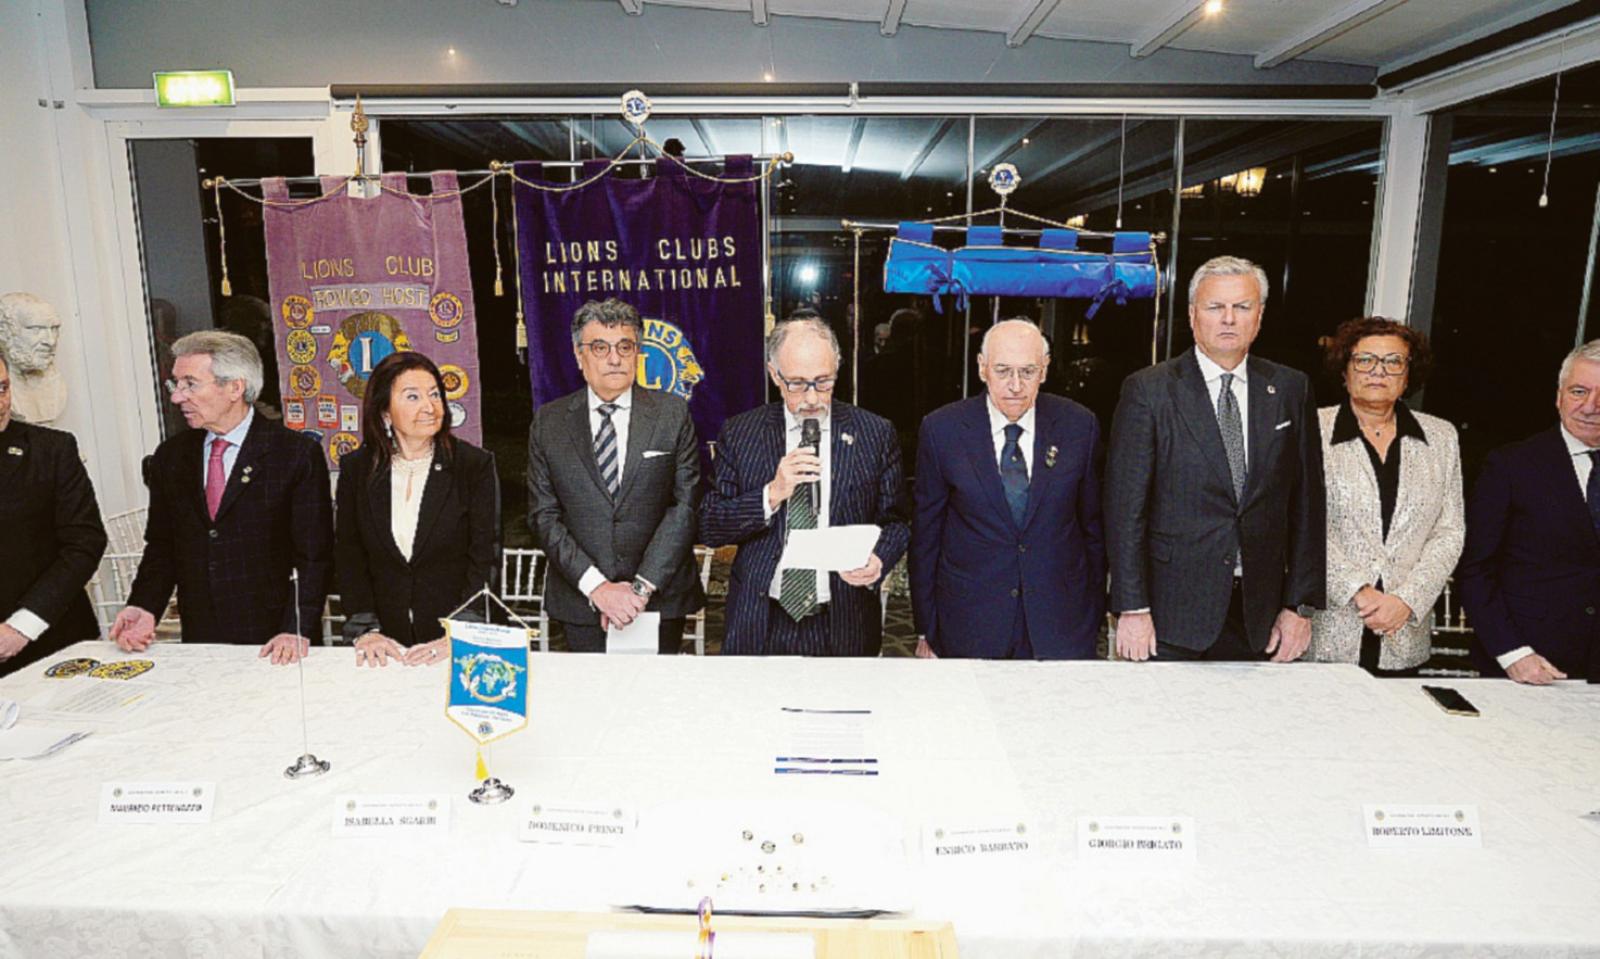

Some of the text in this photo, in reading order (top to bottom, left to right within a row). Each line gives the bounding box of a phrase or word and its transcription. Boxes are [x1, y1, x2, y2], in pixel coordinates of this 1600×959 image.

[546, 236, 736, 264] LIONS CLUBS
[302, 255, 434, 279] LIONS CLUB
[543, 265, 741, 293] INTERNATIONAL
[382, 287, 425, 306] HOST
